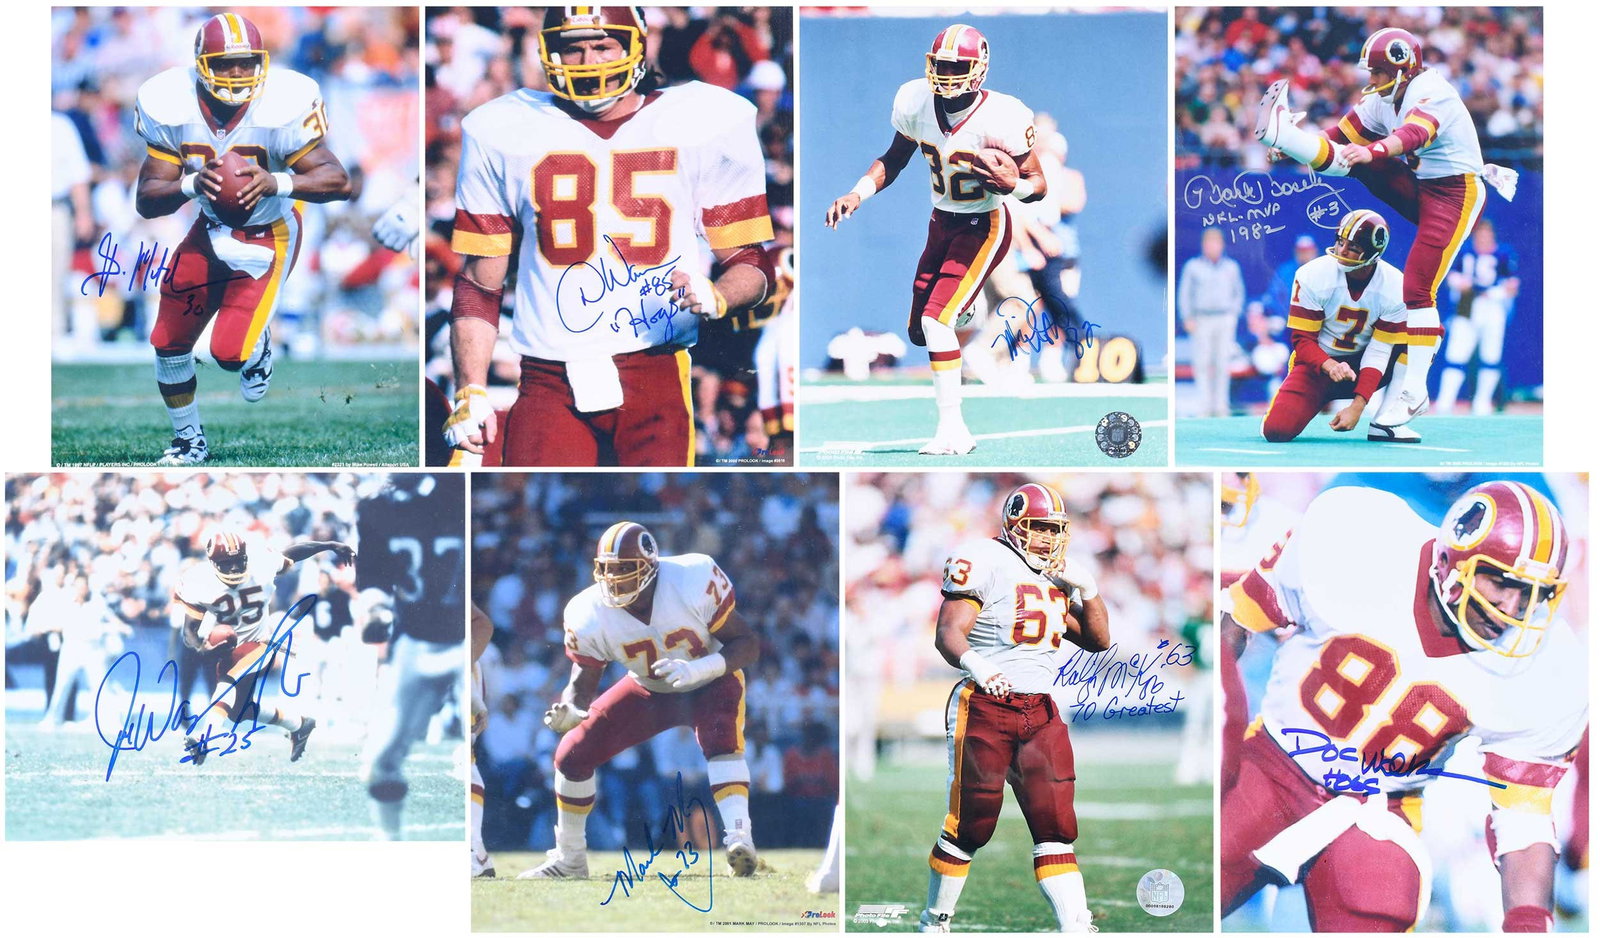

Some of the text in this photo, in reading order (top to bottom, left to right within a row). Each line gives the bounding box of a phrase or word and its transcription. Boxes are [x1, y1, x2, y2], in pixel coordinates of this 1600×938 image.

[531, 147, 678, 270] 85
[1230, 222, 1286, 244] 1982
[639, 265, 678, 297] #85
[1332, 305, 1371, 352] 7
[1073, 337, 1137, 384] 10
[389, 537, 465, 604] 37
[212, 585, 263, 624] 25
[1103, 690, 1185, 719] Greatest
[1299, 633, 1475, 764] 88
